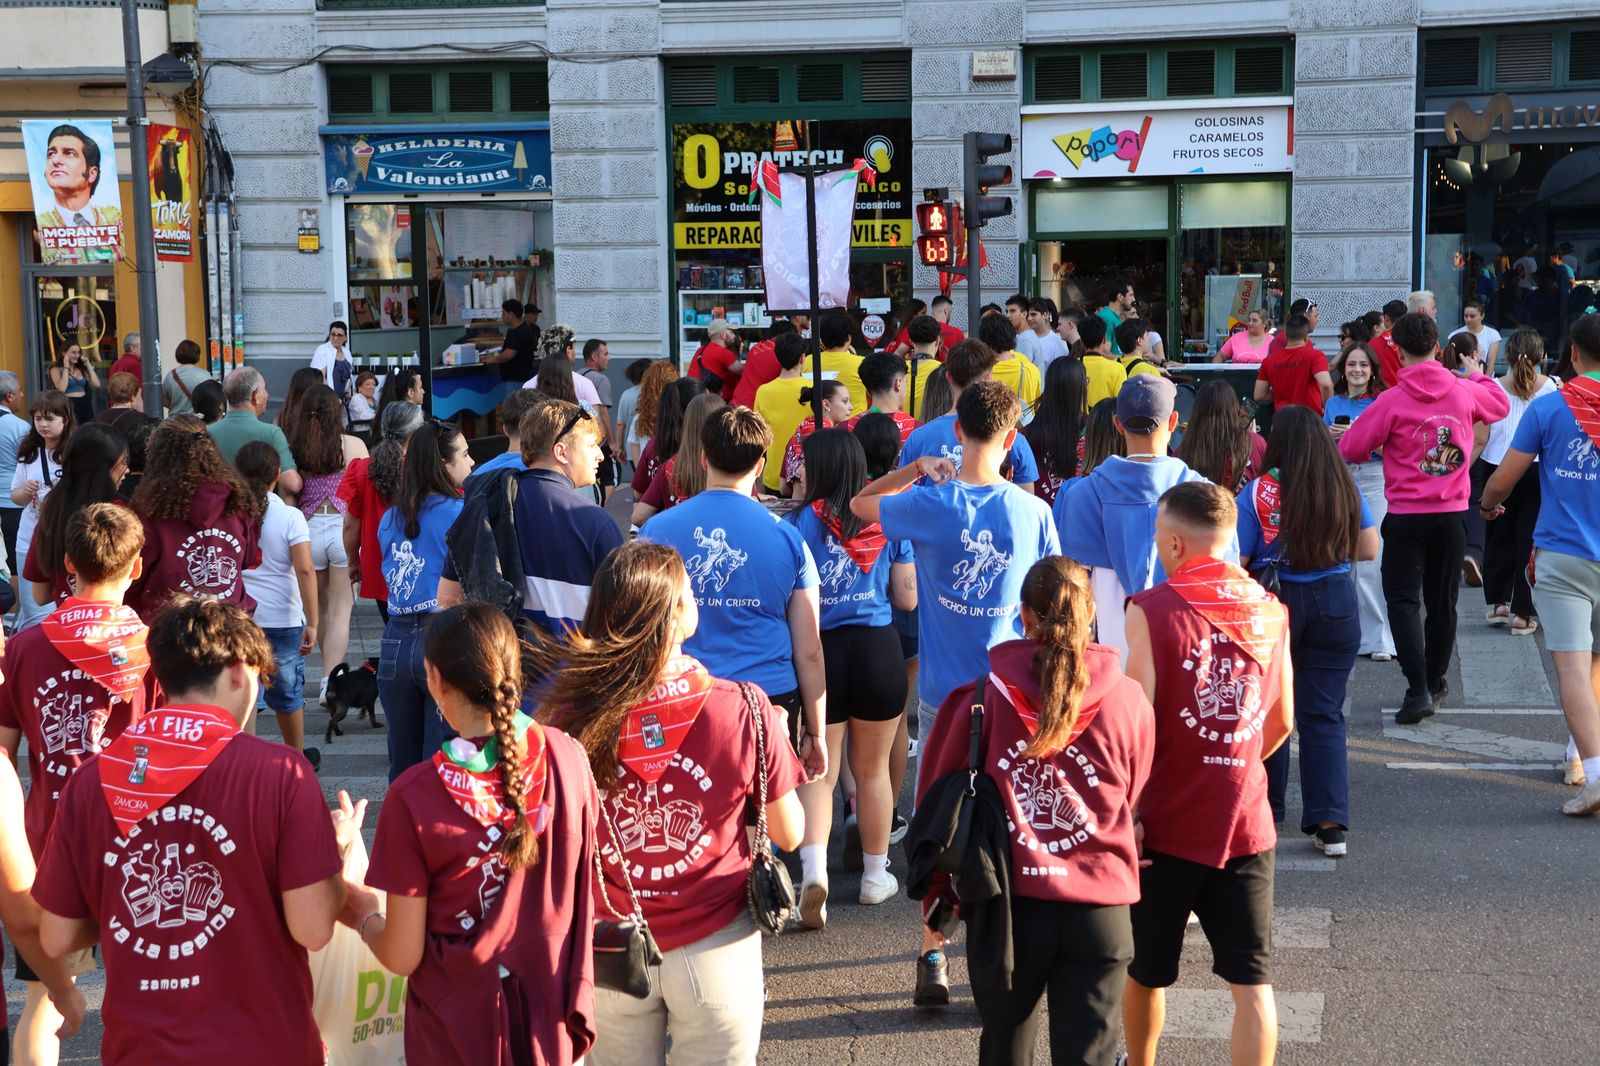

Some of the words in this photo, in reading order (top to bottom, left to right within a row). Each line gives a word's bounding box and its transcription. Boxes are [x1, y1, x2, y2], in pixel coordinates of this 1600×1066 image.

[1194, 116, 1264, 128] GOLOSINAS
[1189, 131, 1264, 144] CARAMELOS
[377, 138, 506, 153] HELADERIA
[422, 152, 464, 168] La
[1173, 148, 1220, 160] FRUTOS
[1223, 147, 1264, 158] SECOS
[376, 167, 510, 186] Valenciana
[151, 199, 191, 226] TOROS
[685, 202, 722, 213] Móviles
[855, 200, 902, 210] ccesorios
[43, 226, 118, 238] MORANTE
[154, 228, 191, 240] ZAMORA
[686, 226, 761, 245] REPARAC
[852, 224, 901, 243] VILES
[58, 237, 119, 248] PUEBLA
[926, 237, 948, 262] 63
[1585, 472, 1597, 481] UN
[413, 598, 438, 612] CRISTO
[708, 598, 722, 607] UN
[725, 598, 760, 607] CRISTO
[938, 594, 968, 615] HECHOS
[969, 606, 984, 616] UN
[986, 605, 1009, 617] CRIS
[60, 608, 103, 625] FERIAS
[74, 625, 103, 638] SAN
[149, 716, 158, 732] Y
[113, 795, 149, 810] ZAMORA
[355, 970, 409, 1022] DI
